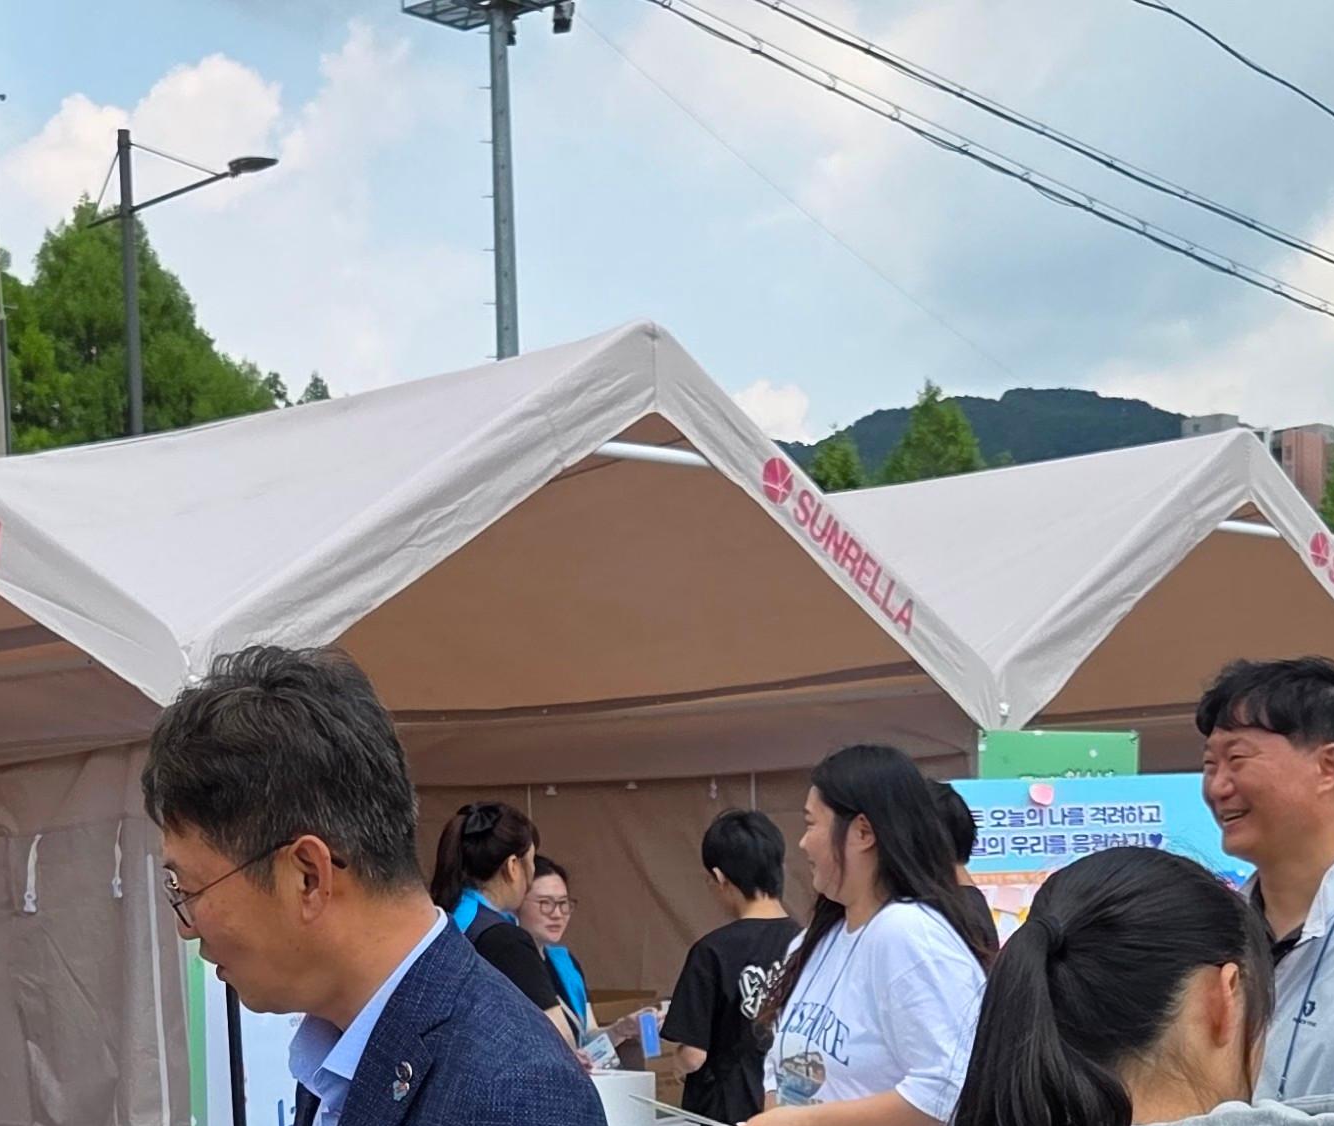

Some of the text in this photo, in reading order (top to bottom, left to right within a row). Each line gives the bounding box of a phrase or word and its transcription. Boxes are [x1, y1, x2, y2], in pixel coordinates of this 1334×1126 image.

[793, 489, 915, 635] SUNRELLA
[989, 808, 1044, 828] 오늘의
[1049, 806, 1085, 827] 나를
[1089, 804, 1162, 825] 격려하고
[971, 836, 1006, 857] 일의
[1010, 835, 1066, 855] 우리를
